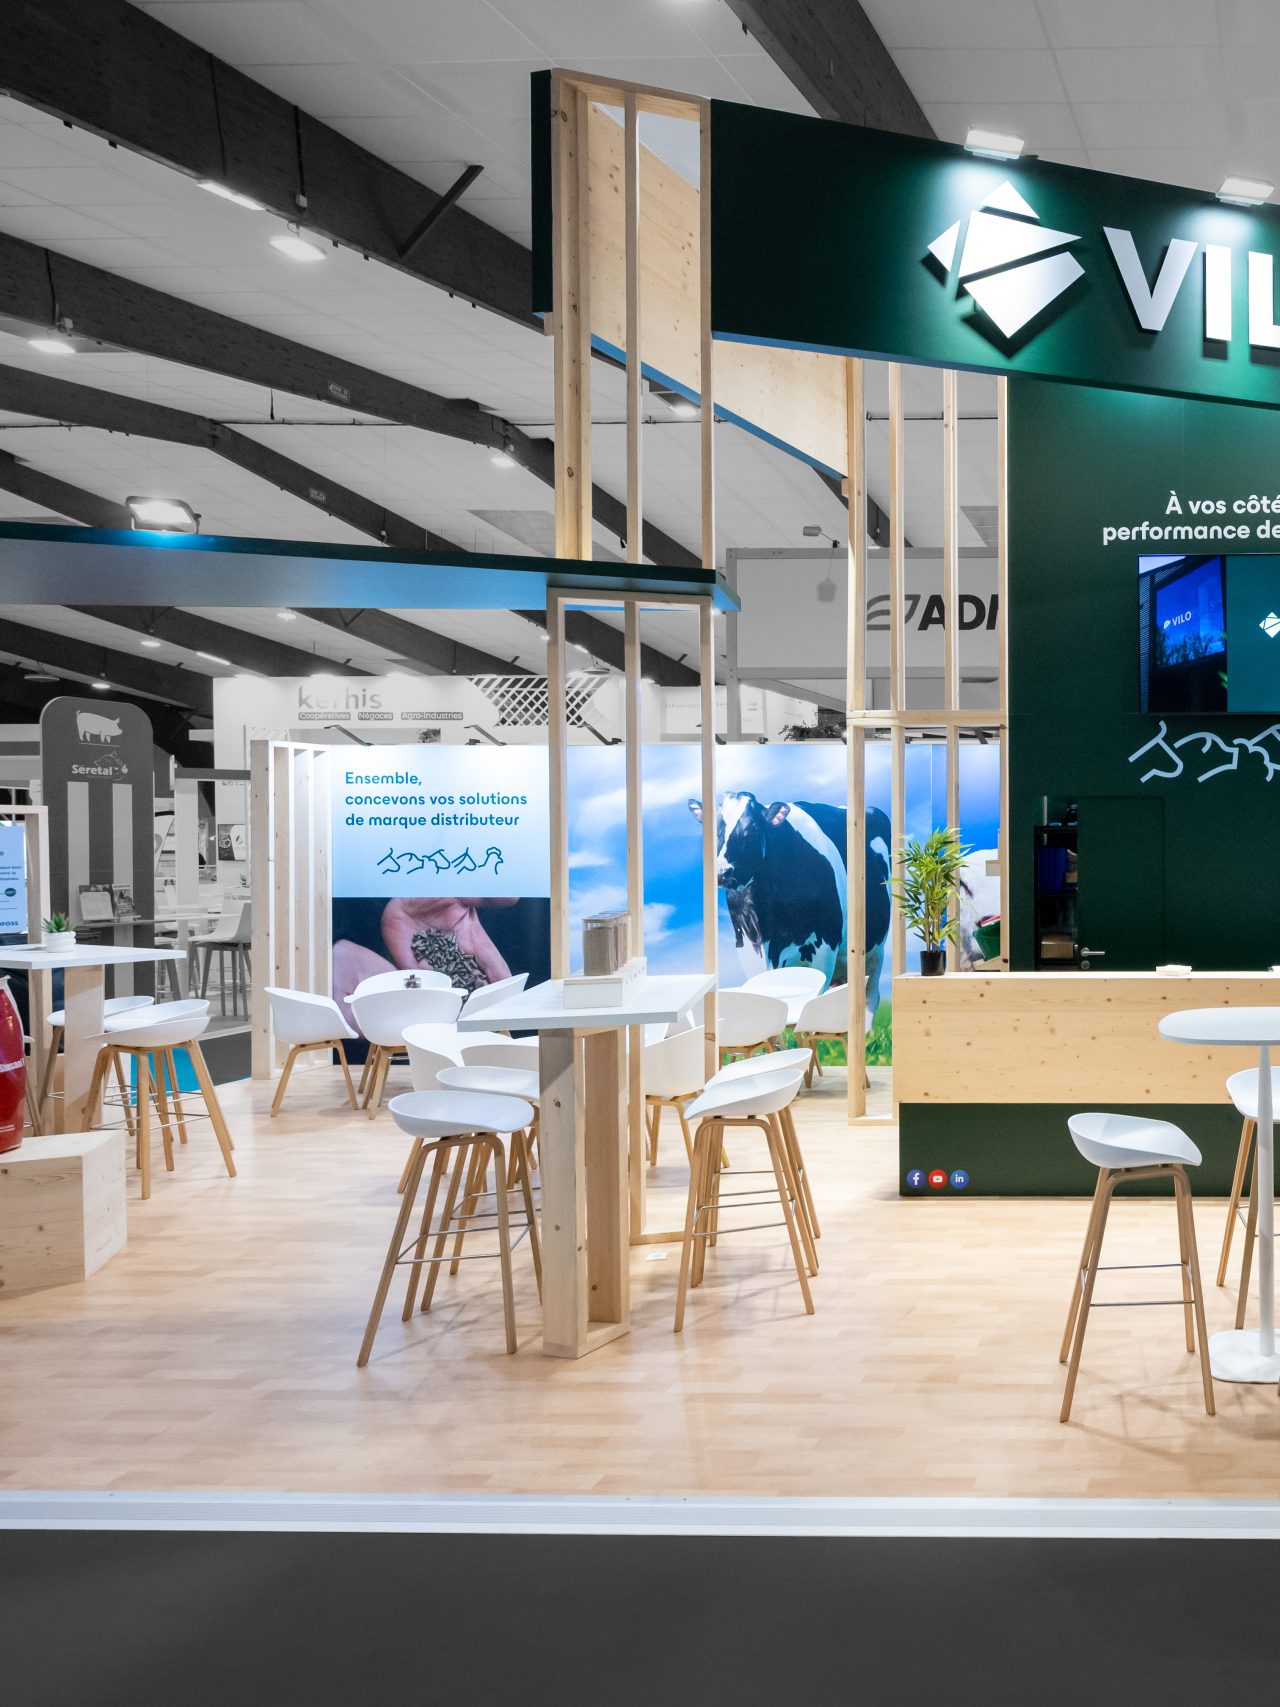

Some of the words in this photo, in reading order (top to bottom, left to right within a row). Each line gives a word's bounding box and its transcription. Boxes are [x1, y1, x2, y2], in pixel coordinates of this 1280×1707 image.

[1165, 490, 1183, 514] À
[1188, 499, 1227, 514] vos
[1102, 520, 1251, 545] performance
[358, 712, 393, 720] Négoces
[71, 764, 113, 776] Seretal
[345, 772, 422, 786] Ensemble,
[345, 795, 425, 805] concevons
[430, 795, 455, 805] vos
[459, 792, 527, 805] solutions
[345, 813, 364, 826] de
[369, 816, 426, 829] marque
[431, 813, 519, 826] distributeur
